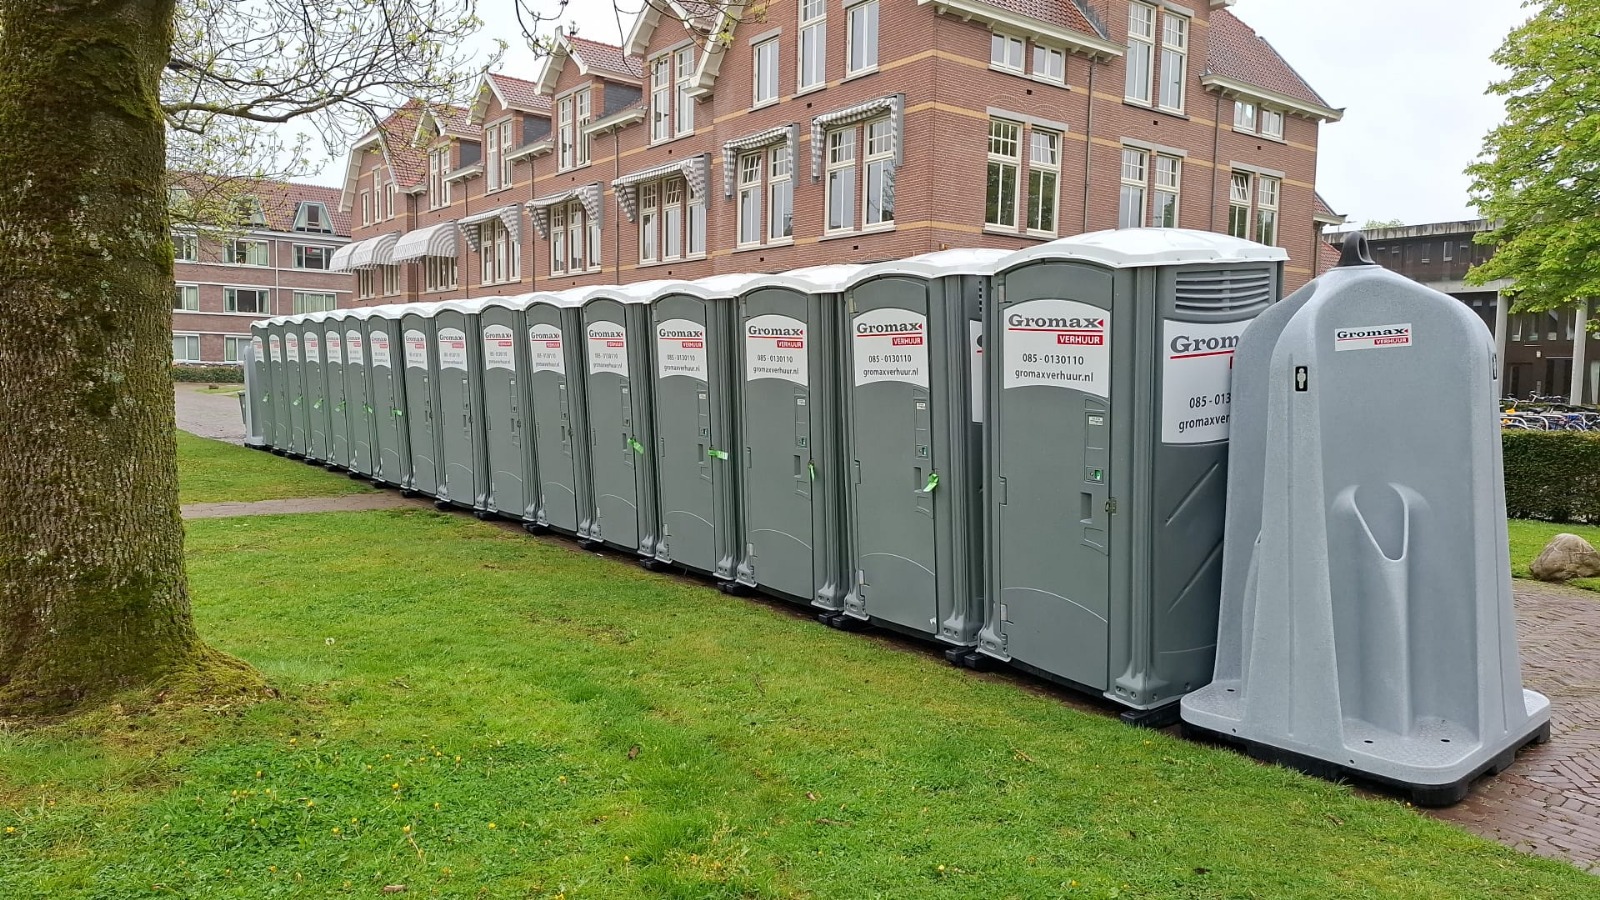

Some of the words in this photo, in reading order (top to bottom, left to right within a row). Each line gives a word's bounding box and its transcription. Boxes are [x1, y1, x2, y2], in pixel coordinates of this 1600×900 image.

[1008, 314, 1099, 328] Gromax
[659, 329, 700, 337] Gromax
[748, 326, 800, 335] Gromax
[857, 323, 919, 333] Gromax
[1337, 328, 1405, 338] Gromax
[1060, 336, 1100, 344] VERHUUR
[1170, 335, 1239, 353] Grom
[1376, 337, 1407, 345] VERHUUR
[1044, 354, 1084, 365] 0130110
[863, 368, 918, 377] gromaxverhuur.nl
[1015, 369, 1093, 382] gromaxverhuur.nl
[1189, 396, 1207, 408] 085
[1214, 392, 1231, 405] 013
[1179, 414, 1230, 433] gromaxver
